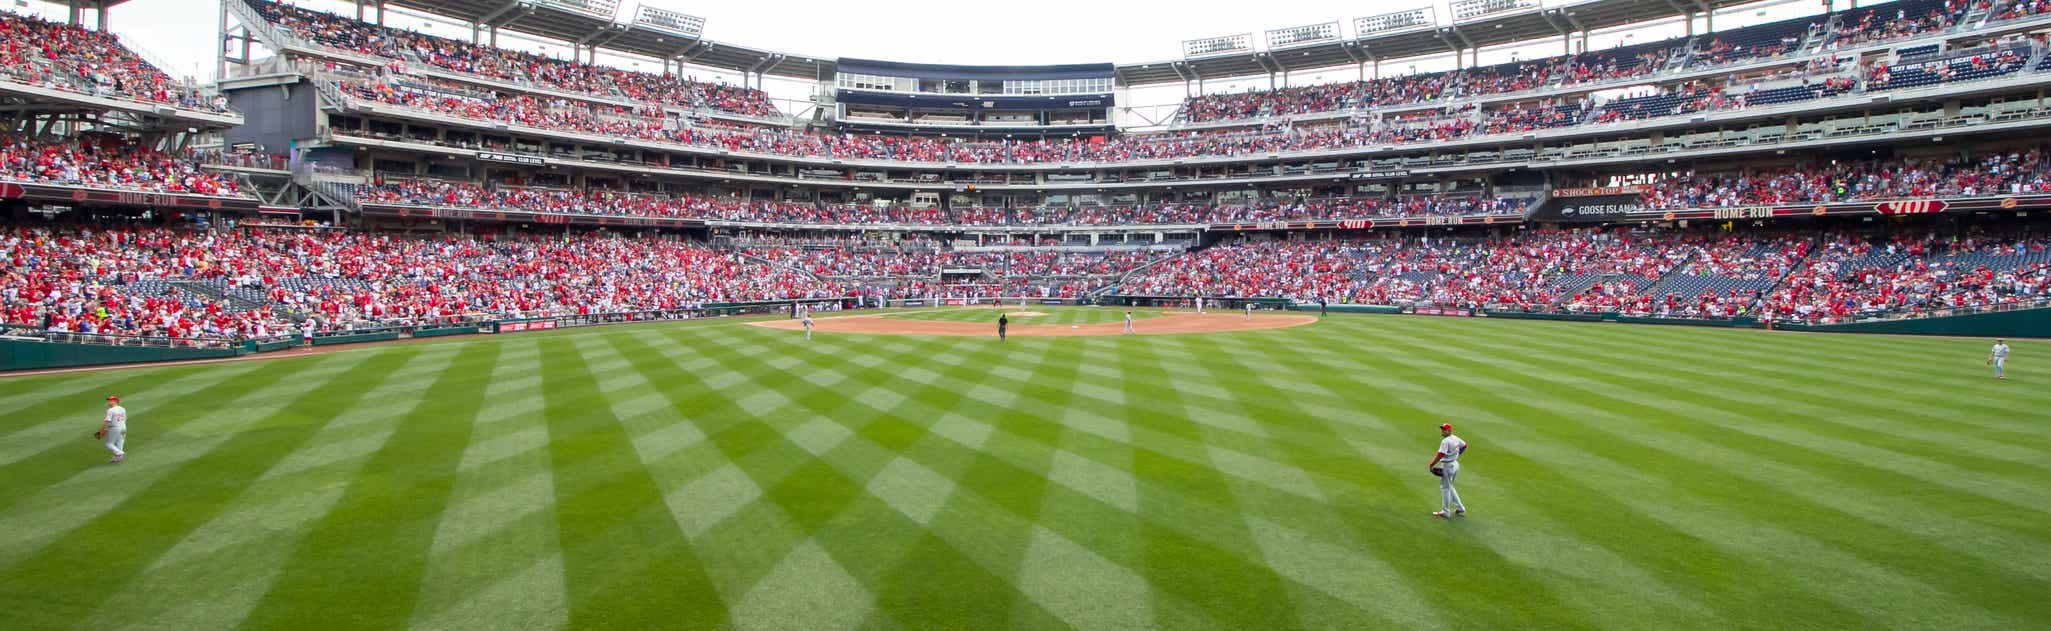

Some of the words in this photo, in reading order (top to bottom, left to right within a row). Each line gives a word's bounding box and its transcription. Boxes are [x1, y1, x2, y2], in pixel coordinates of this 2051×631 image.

[1562, 188, 1594, 197] SHOCK
[1599, 187, 1618, 195] TOP
[119, 192, 153, 205] HOME
[154, 194, 177, 206] RUN
[1579, 205, 1604, 215] GOOSE
[1714, 207, 1746, 219] HOME
[1749, 207, 1773, 218] RUN
